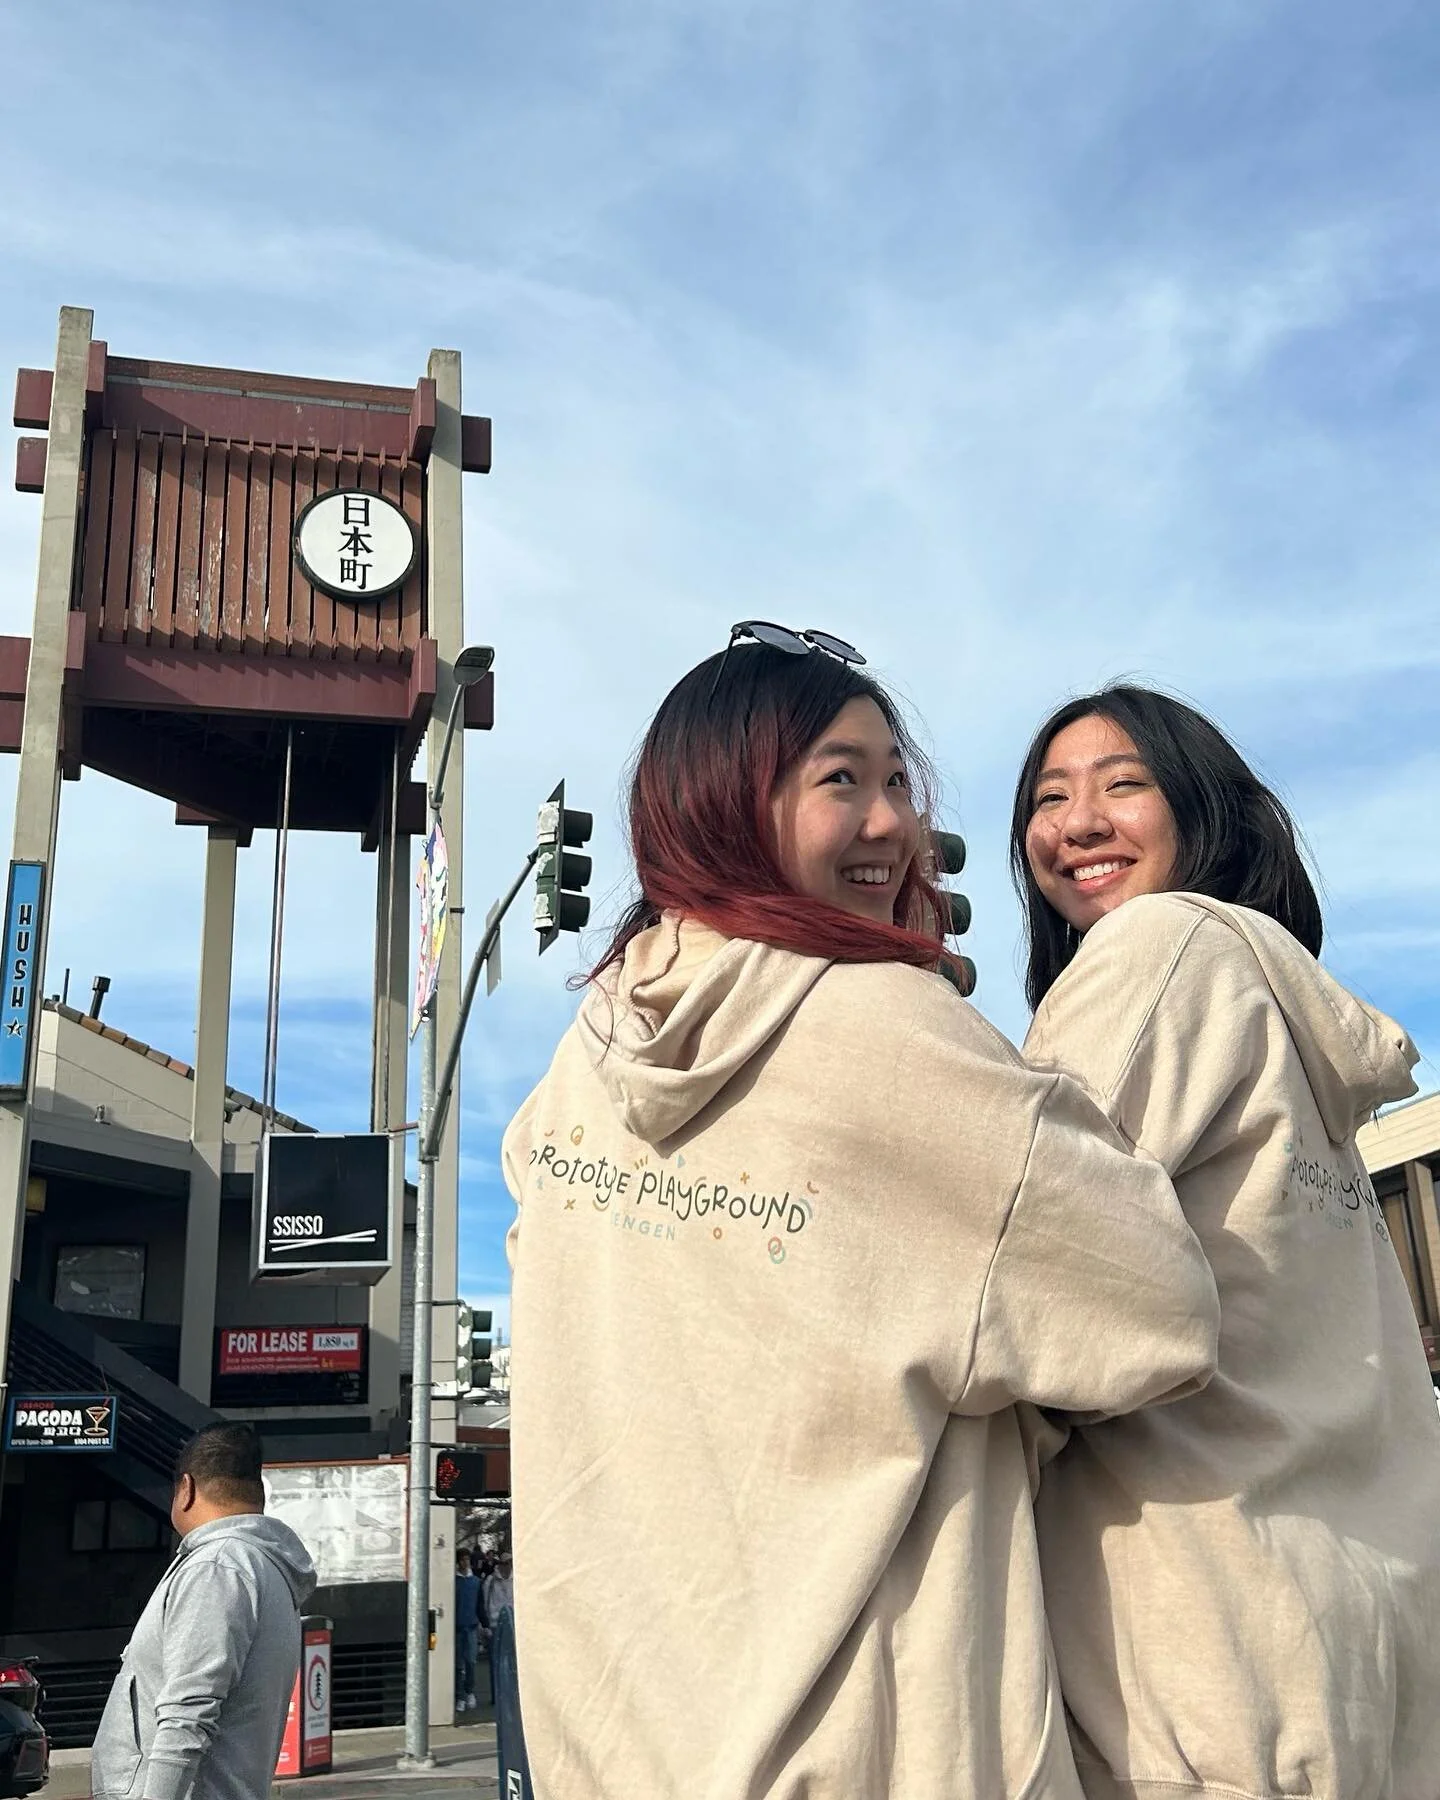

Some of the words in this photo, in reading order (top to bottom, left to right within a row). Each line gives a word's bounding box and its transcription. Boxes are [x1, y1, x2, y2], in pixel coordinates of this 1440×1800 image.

[338, 495, 374, 590] 日本町
[11, 904, 32, 1008] HUSH
[273, 1215, 323, 1236] SSISSO
[228, 1332, 258, 1353] FOR
[261, 1331, 308, 1352] LEASE
[16, 1410, 83, 1426] PAGODA
